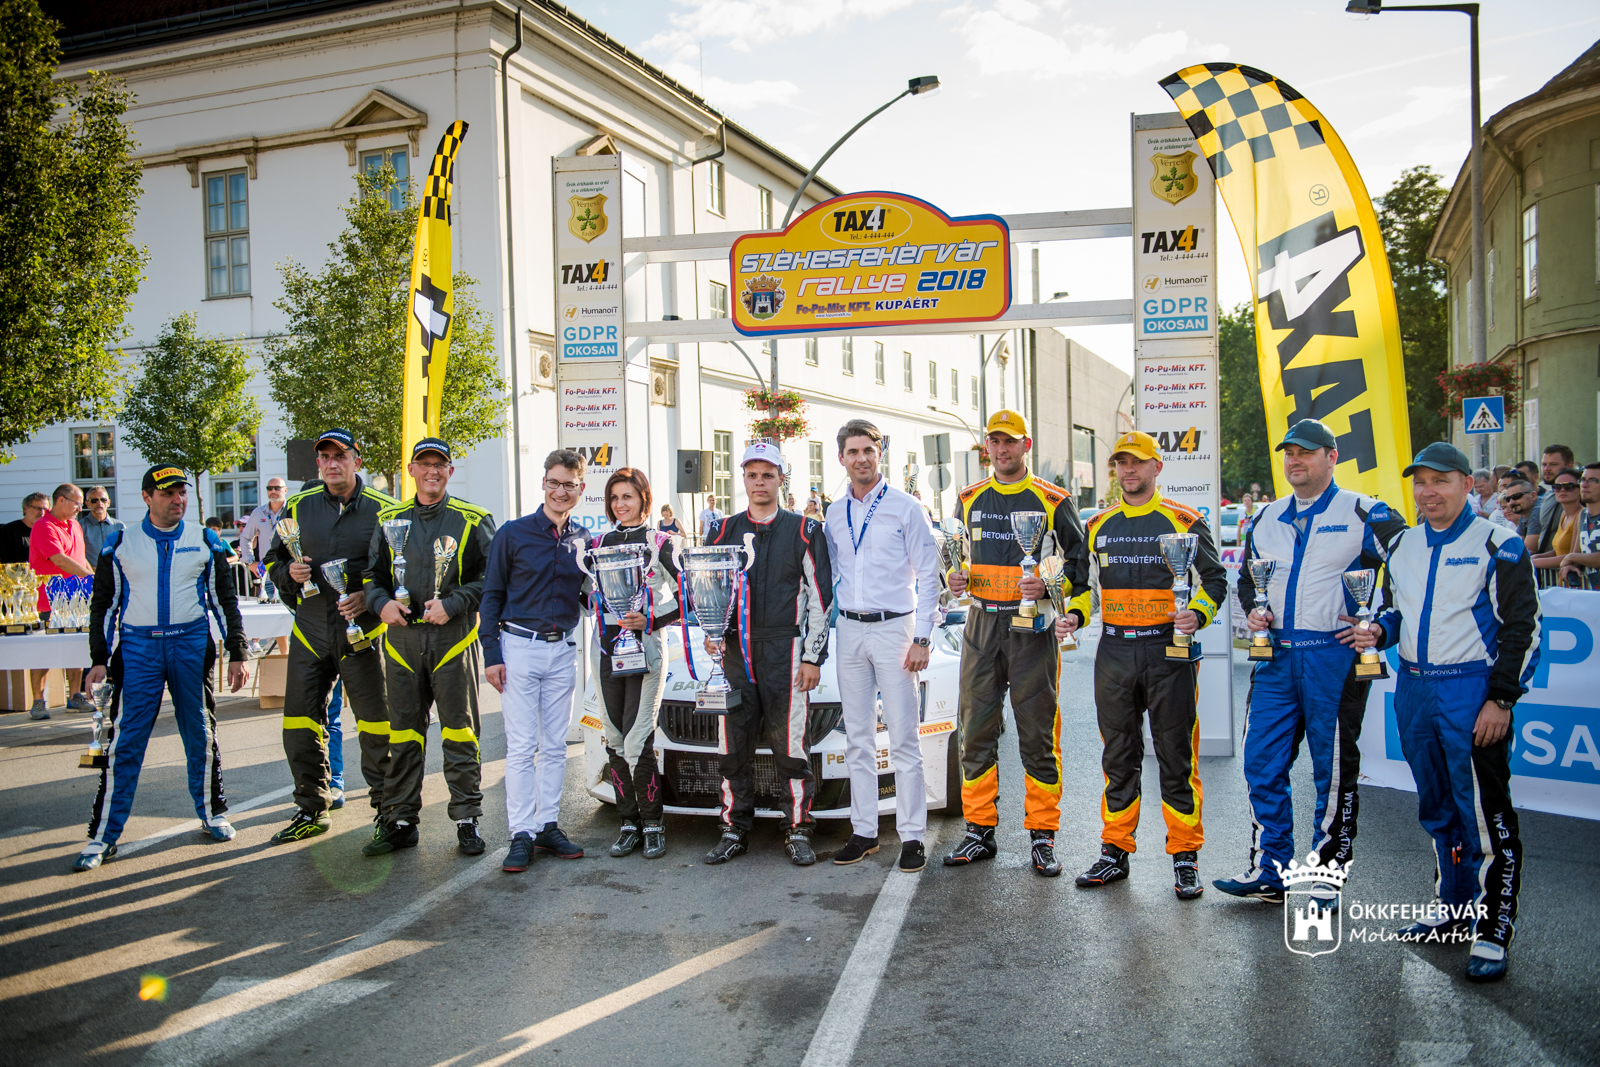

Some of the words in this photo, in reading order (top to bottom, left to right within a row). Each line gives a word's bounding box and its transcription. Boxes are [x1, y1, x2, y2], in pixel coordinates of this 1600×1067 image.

[1175, 252, 1208, 260] 4-444-444
[916, 268, 987, 292] 2018
[795, 302, 846, 314] Fo-Pu-Mix
[847, 301, 871, 312] KFT.
[875, 298, 940, 311] KUPÁÉRT
[1143, 297, 1207, 315] GDPR
[1146, 319, 1204, 331] OKOSAN
[564, 325, 617, 341] GDPR
[566, 345, 615, 356] OKOSAN
[1144, 365, 1186, 373] Fo-Pu-Mix
[1189, 364, 1206, 372] KFT.
[565, 404, 600, 412] Fo-Pu-Mix
[1145, 402, 1186, 410] Fo-Pu-Mix
[1167, 484, 1210, 492] HumanoiT
[1178, 514, 1192, 524] OMP
[974, 579, 991, 587] SIVA
[995, 580, 1019, 589] GRO
[1105, 604, 1125, 612] SIVA
[1129, 603, 1168, 613] GROUP
[1343, 791, 1354, 822] TEAM
[1335, 826, 1352, 859] RALLYE
[1501, 849, 1515, 896] RALLYE
[1494, 901, 1511, 940] HADIK
